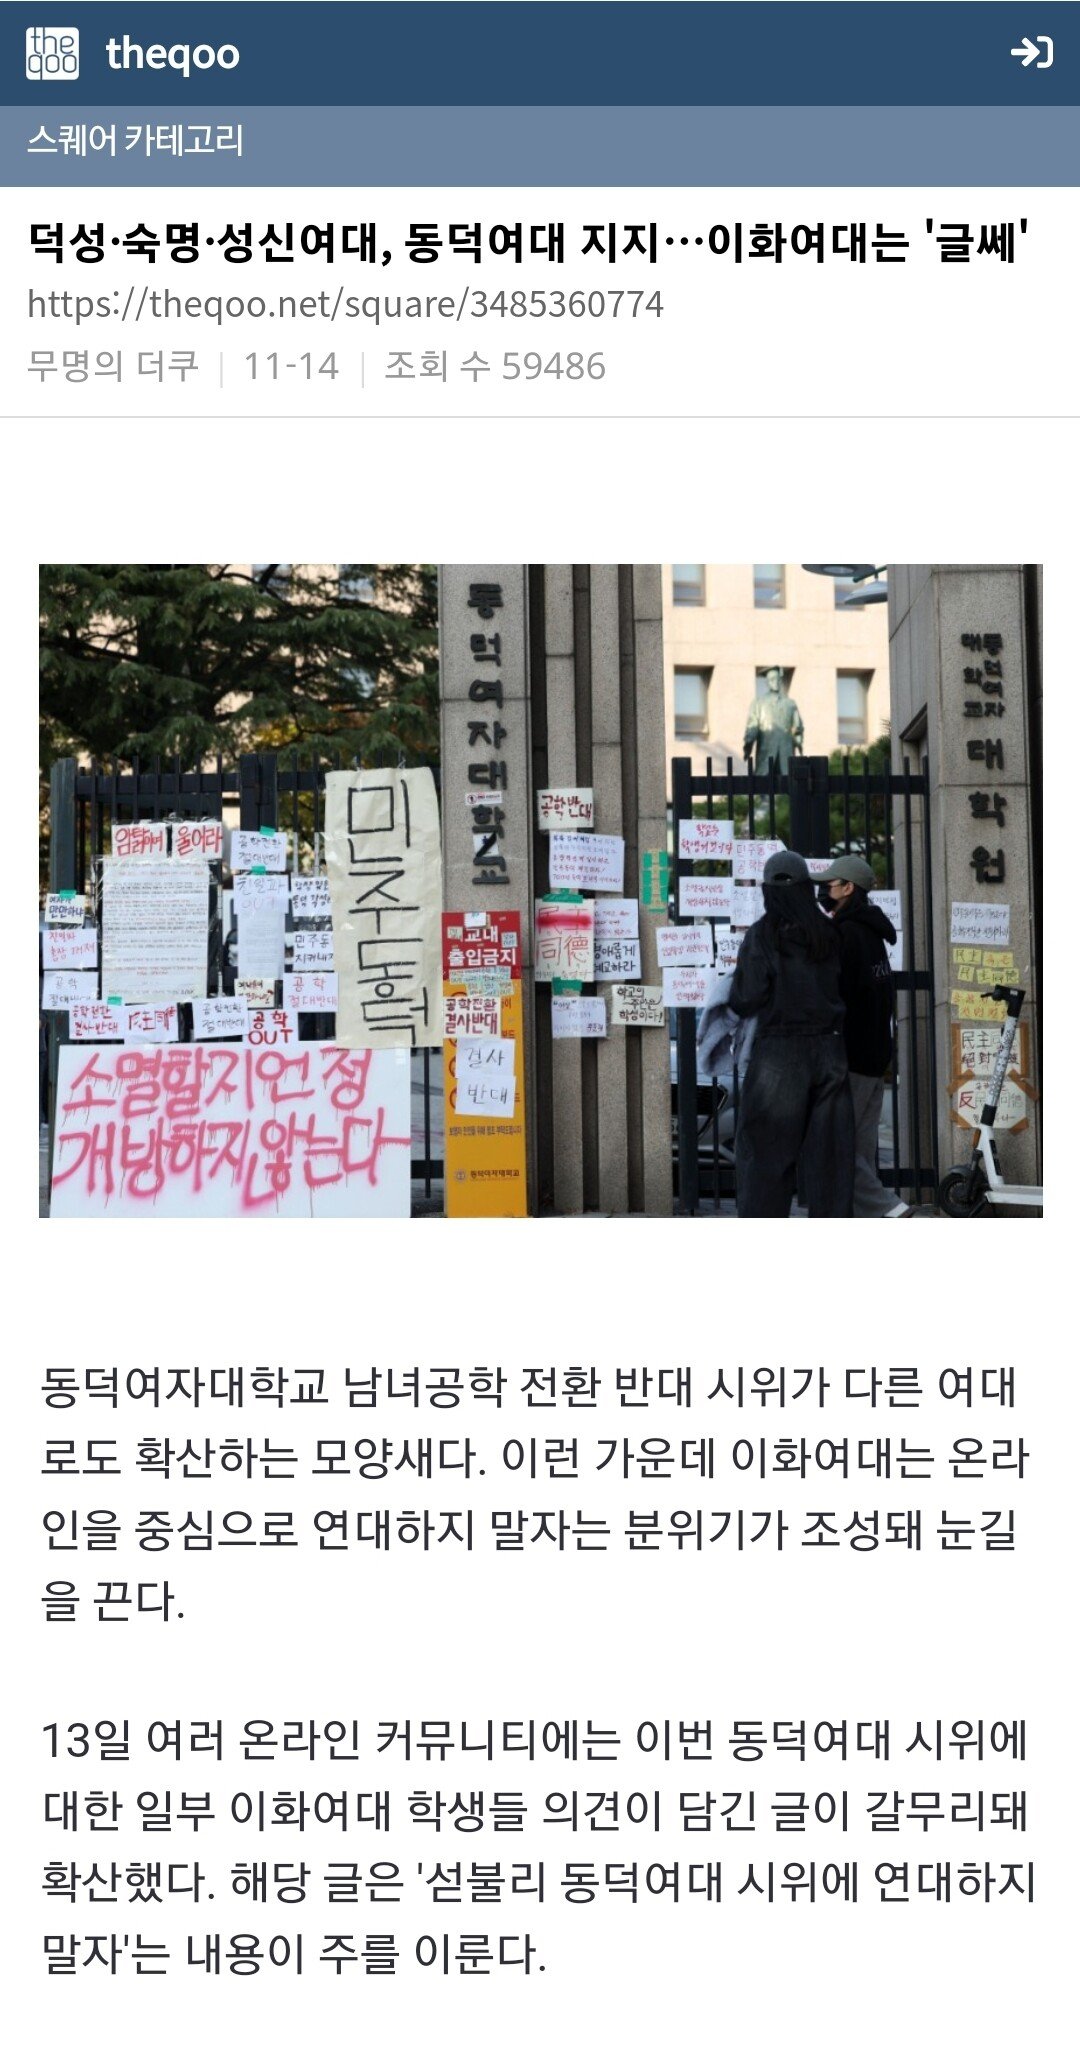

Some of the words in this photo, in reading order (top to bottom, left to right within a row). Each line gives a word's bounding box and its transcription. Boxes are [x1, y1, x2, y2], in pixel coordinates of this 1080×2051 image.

[30, 27, 74, 54] the
[105, 35, 240, 77] theqoo
[28, 54, 77, 80] qoo
[27, 125, 116, 156] 스퀘어
[125, 125, 242, 156] 카테고리
[30, 222, 392, 267] 덕성·숙명·성신여대,
[405, 222, 565, 263] 동덕여대
[926, 218, 1028, 263] '글쎄'
[28, 286, 664, 325] https://theqoo.net/square/3485360774
[28, 350, 121, 382] 무명의
[138, 350, 199, 382] 더쿠
[245, 352, 339, 380] 11-14
[385, 350, 447, 382] 조회
[460, 350, 491, 382] 수
[503, 352, 606, 380] 59486
[467, 583, 510, 885] 동덕여자대학교
[541, 795, 592, 820] 공학반대
[967, 738, 1007, 884] 대학원
[348, 778, 429, 1046] 민주동덕
[464, 925, 499, 943] 교내
[448, 947, 517, 967] 출입금지
[293, 976, 327, 993] 공학
[253, 1010, 289, 1030] 공학
[446, 998, 498, 1011] 공학전환
[247, 1028, 294, 1046] OUT
[445, 1012, 498, 1035] 결사반대
[465, 1047, 506, 1069] 결사
[62, 1047, 373, 1120] 소멸할지언정
[467, 1083, 509, 1105] 반대
[41, 1366, 328, 1408] 동덕여자대학교
[346, 1366, 507, 1408] 남녀공학
[520, 1366, 601, 1408] 전환
[616, 1366, 691, 1408] 반대
[707, 1366, 830, 1408] 시위가
[846, 1366, 922, 1408] 다른
[939, 1366, 1014, 1408] 여대
[41, 1438, 121, 1479] 로도
[136, 1438, 298, 1479] 확산하는
[312, 1438, 485, 1479] 모양새다.
[503, 1438, 578, 1479] 이런
[596, 1438, 713, 1479] 가운데
[733, 1438, 934, 1479] 이화여대는
[949, 1438, 1029, 1479] 온라
[43, 1510, 121, 1551] 인을
[135, 1510, 298, 1551] 중심으로
[314, 1510, 472, 1551] 연대하지
[492, 1510, 610, 1551] 말자는
[625, 1510, 788, 1551] 분위기가
[802, 1510, 921, 1551] 조성돼
[937, 1510, 1014, 1551] 눈길
[41, 1581, 79, 1621] 을
[94, 1581, 184, 1621] 끈다.
[43, 1720, 129, 1761] 13일
[148, 1720, 222, 1761] 여러
[240, 1720, 359, 1761] 온라인
[377, 1720, 620, 1761] 커뮤니티에는
[637, 1720, 712, 1761] 이번
[729, 1720, 889, 1761] 동덕여대
[906, 1720, 1025, 1761] 시위에
[45, 1791, 123, 1832] 대한
[137, 1791, 215, 1832] 일부
[231, 1791, 389, 1832] 이화여대
[408, 1791, 527, 1832] 학생들
[543, 1791, 659, 1832] 의견이
[680, 1791, 755, 1832] 담긴
[771, 1791, 847, 1832] 글이
[866, 1791, 1026, 1832] 갈무리돼
[42, 1862, 214, 1903] 확산했다.
[231, 1862, 311, 1903] 해당
[324, 1862, 403, 1903] 글은
[418, 1862, 543, 1903] '섣불리
[561, 1862, 721, 1903] 동덕여대
[738, 1862, 857, 1903] 시위에
[875, 1862, 1033, 1903] 연대하지
[44, 1934, 170, 1975] 말자'는
[188, 1934, 302, 1975] 내용이
[320, 1934, 399, 1975] 주를
[416, 1934, 545, 1975] 이룬다.
